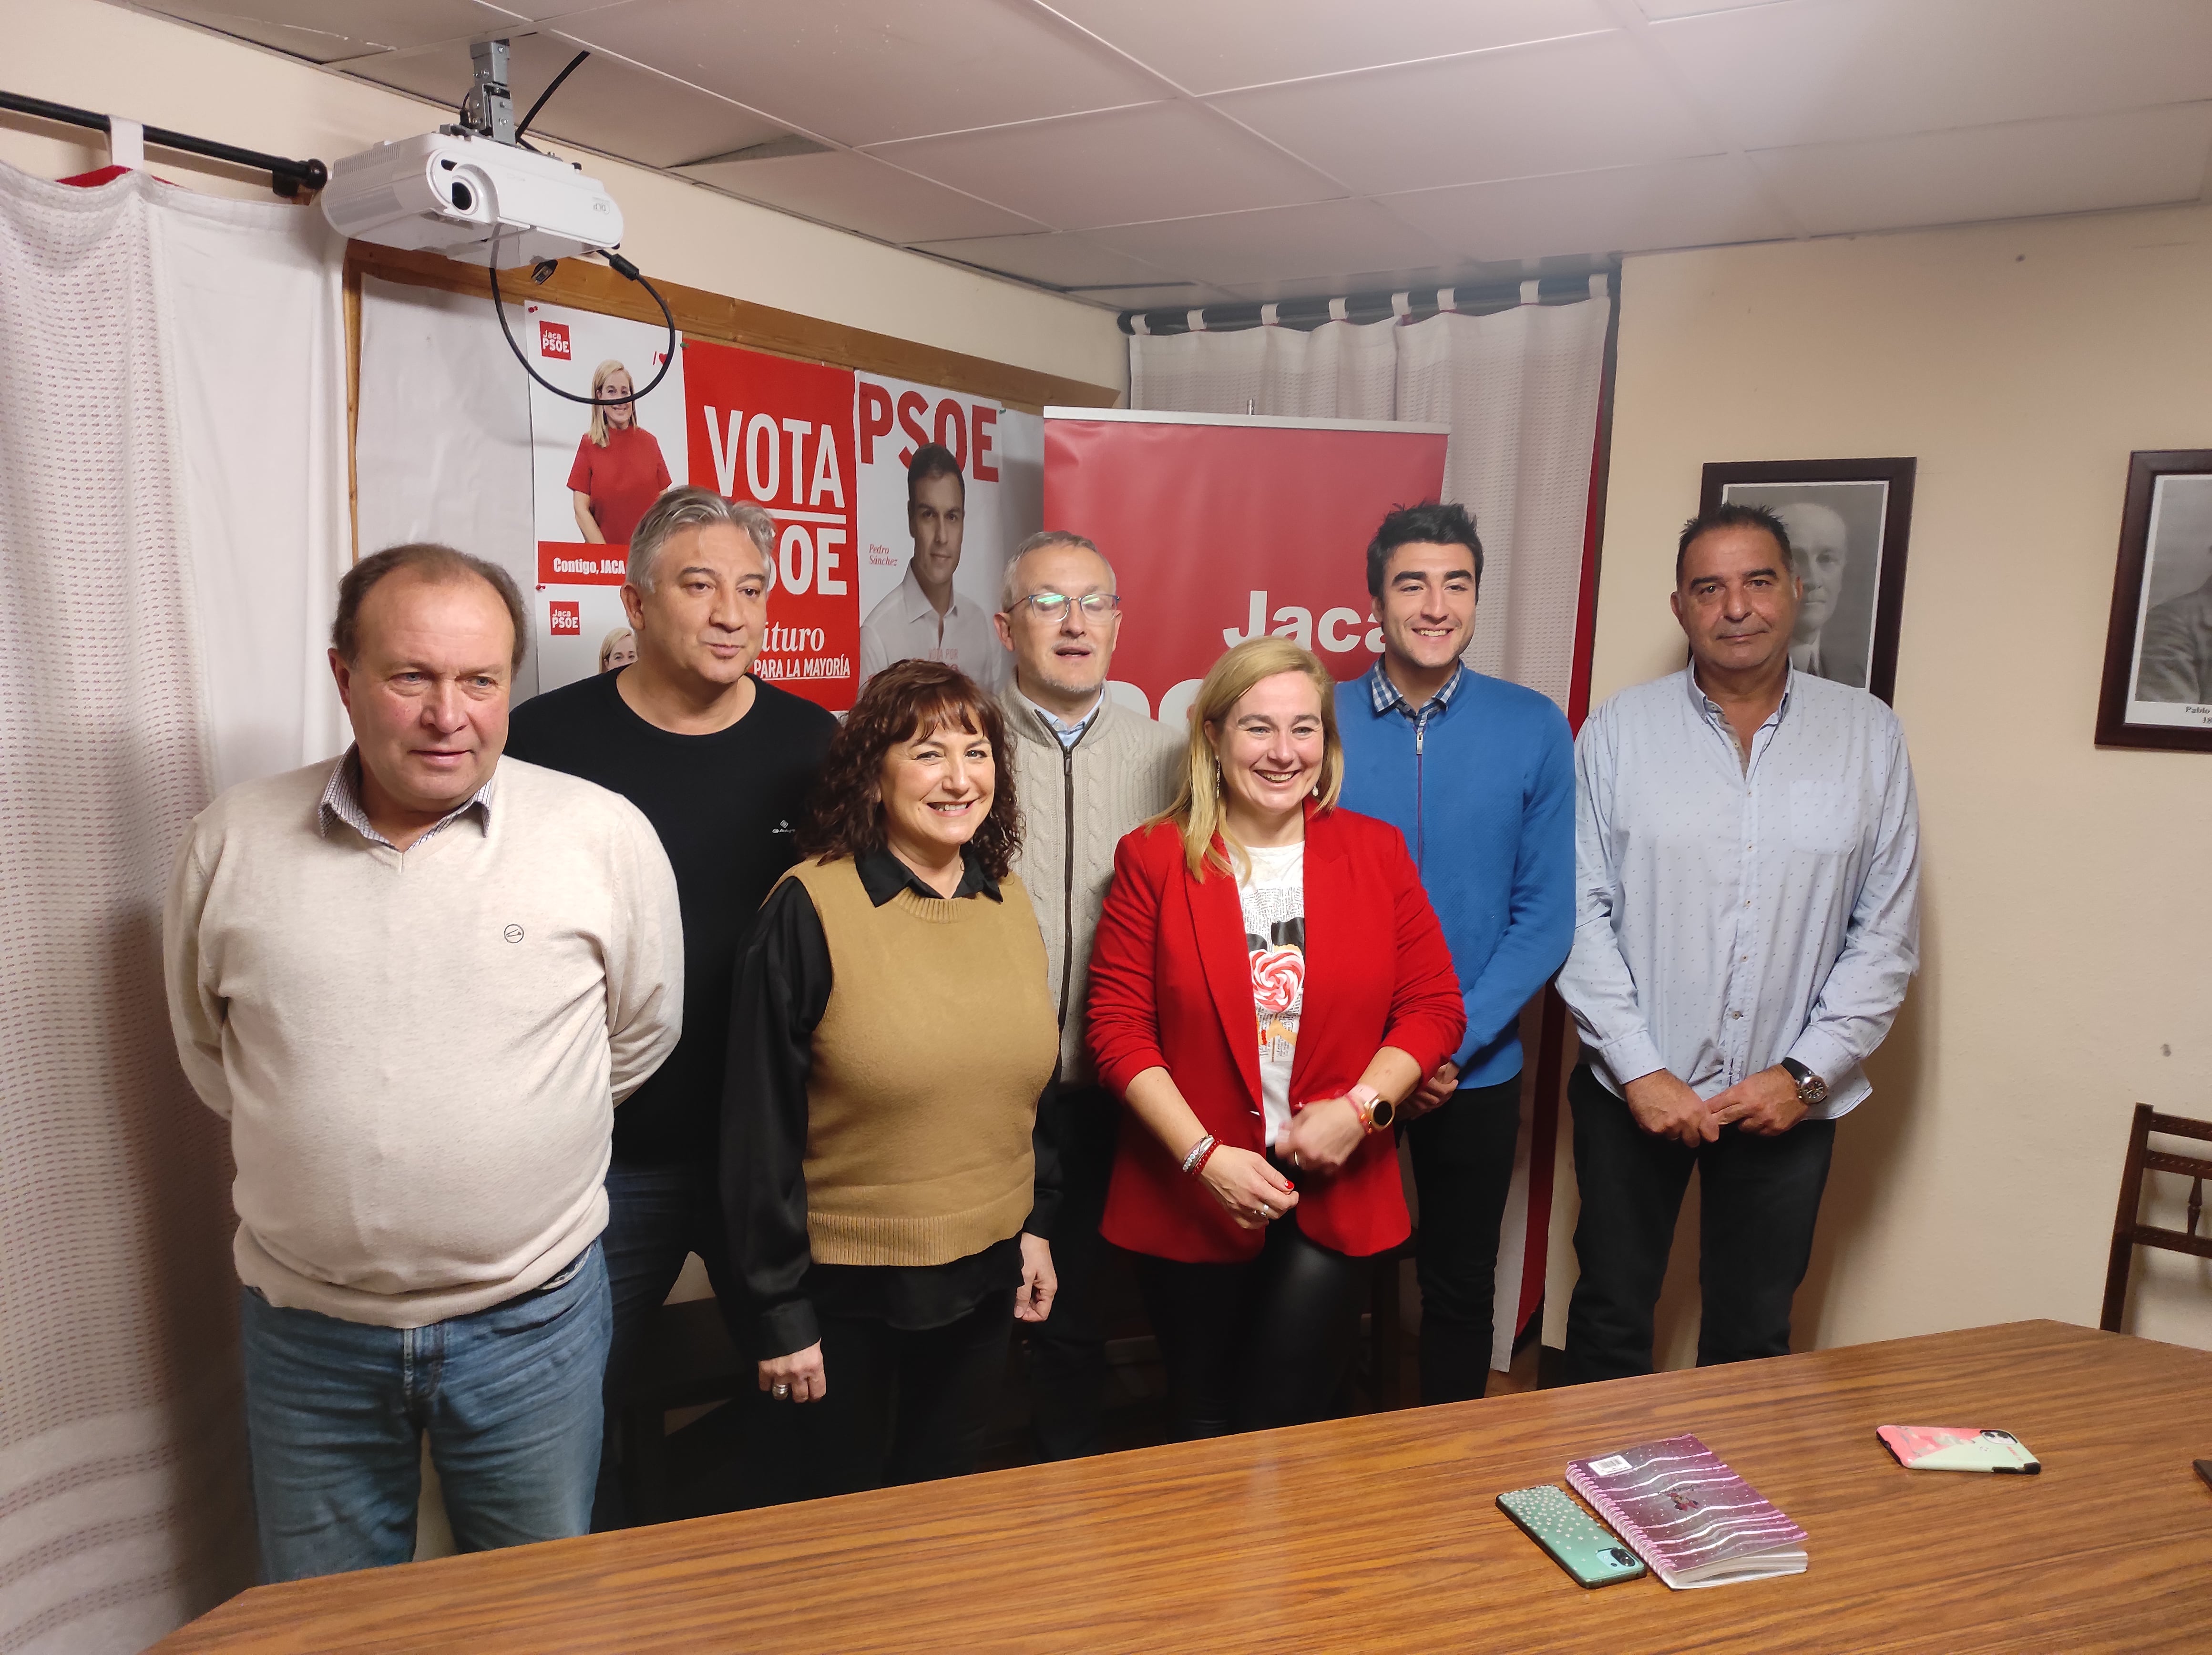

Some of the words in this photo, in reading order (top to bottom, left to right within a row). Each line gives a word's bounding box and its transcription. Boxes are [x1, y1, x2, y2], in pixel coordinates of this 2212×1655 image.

[543, 337, 569, 353] PSOE
[859, 381, 1000, 482] PSOE
[704, 405, 846, 509] VOTA
[869, 544, 890, 554] Pedro
[553, 557, 599, 575] Contigo,
[600, 559, 625, 574] JACA
[870, 555, 898, 566] Sánchez
[552, 609, 571, 617] Jaca
[552, 617, 579, 628] PSOE
[945, 648, 958, 659] POR
[754, 659, 783, 678] PARA
[786, 658, 800, 677] LA
[803, 653, 850, 677] MAYORÍA
